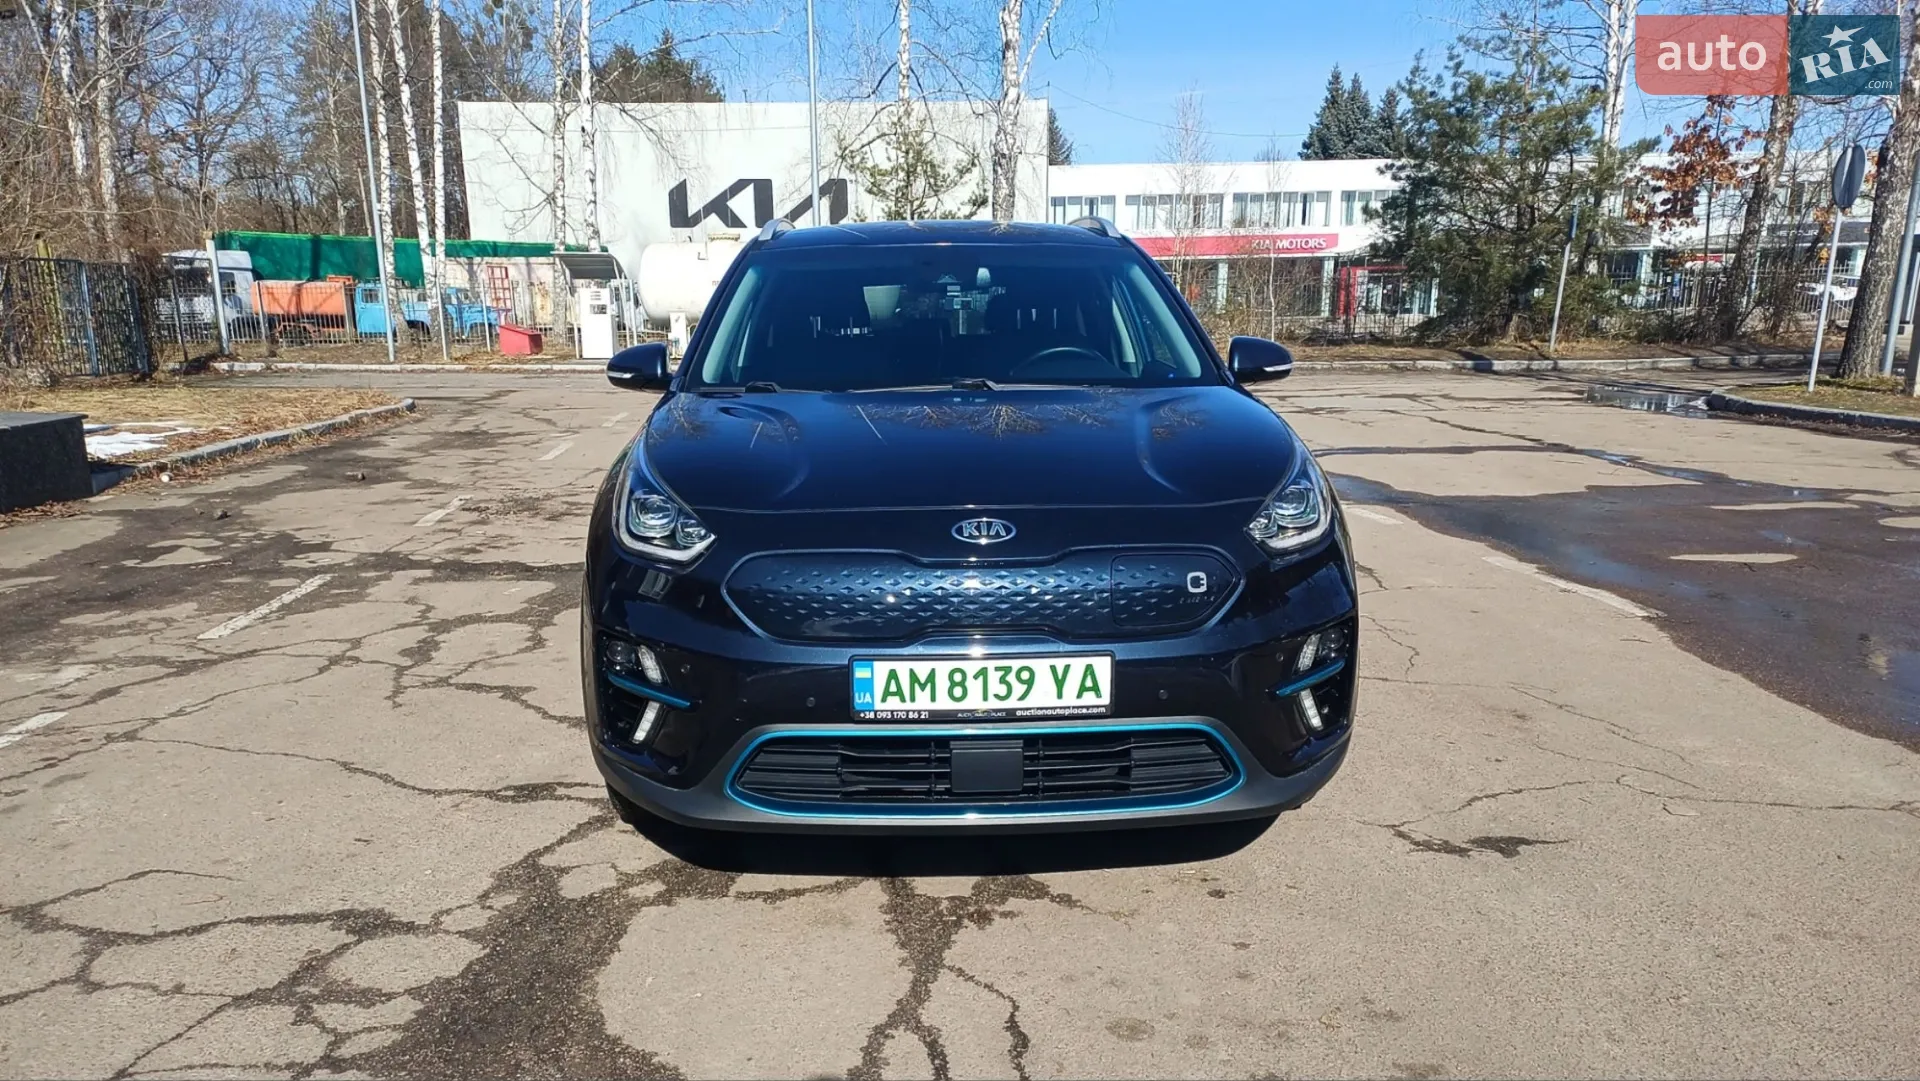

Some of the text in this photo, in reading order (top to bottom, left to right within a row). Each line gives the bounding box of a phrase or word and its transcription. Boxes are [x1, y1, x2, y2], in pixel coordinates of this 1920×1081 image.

[1275, 238, 1327, 249] MOTORS
[962, 522, 1007, 537] KIA
[880, 663, 1103, 703] AM 8139 YA
[855, 692, 872, 703] UA
[860, 710, 929, 719] +38 093 170 86 21
[1015, 706, 1106, 717] auctionautoplace.com
